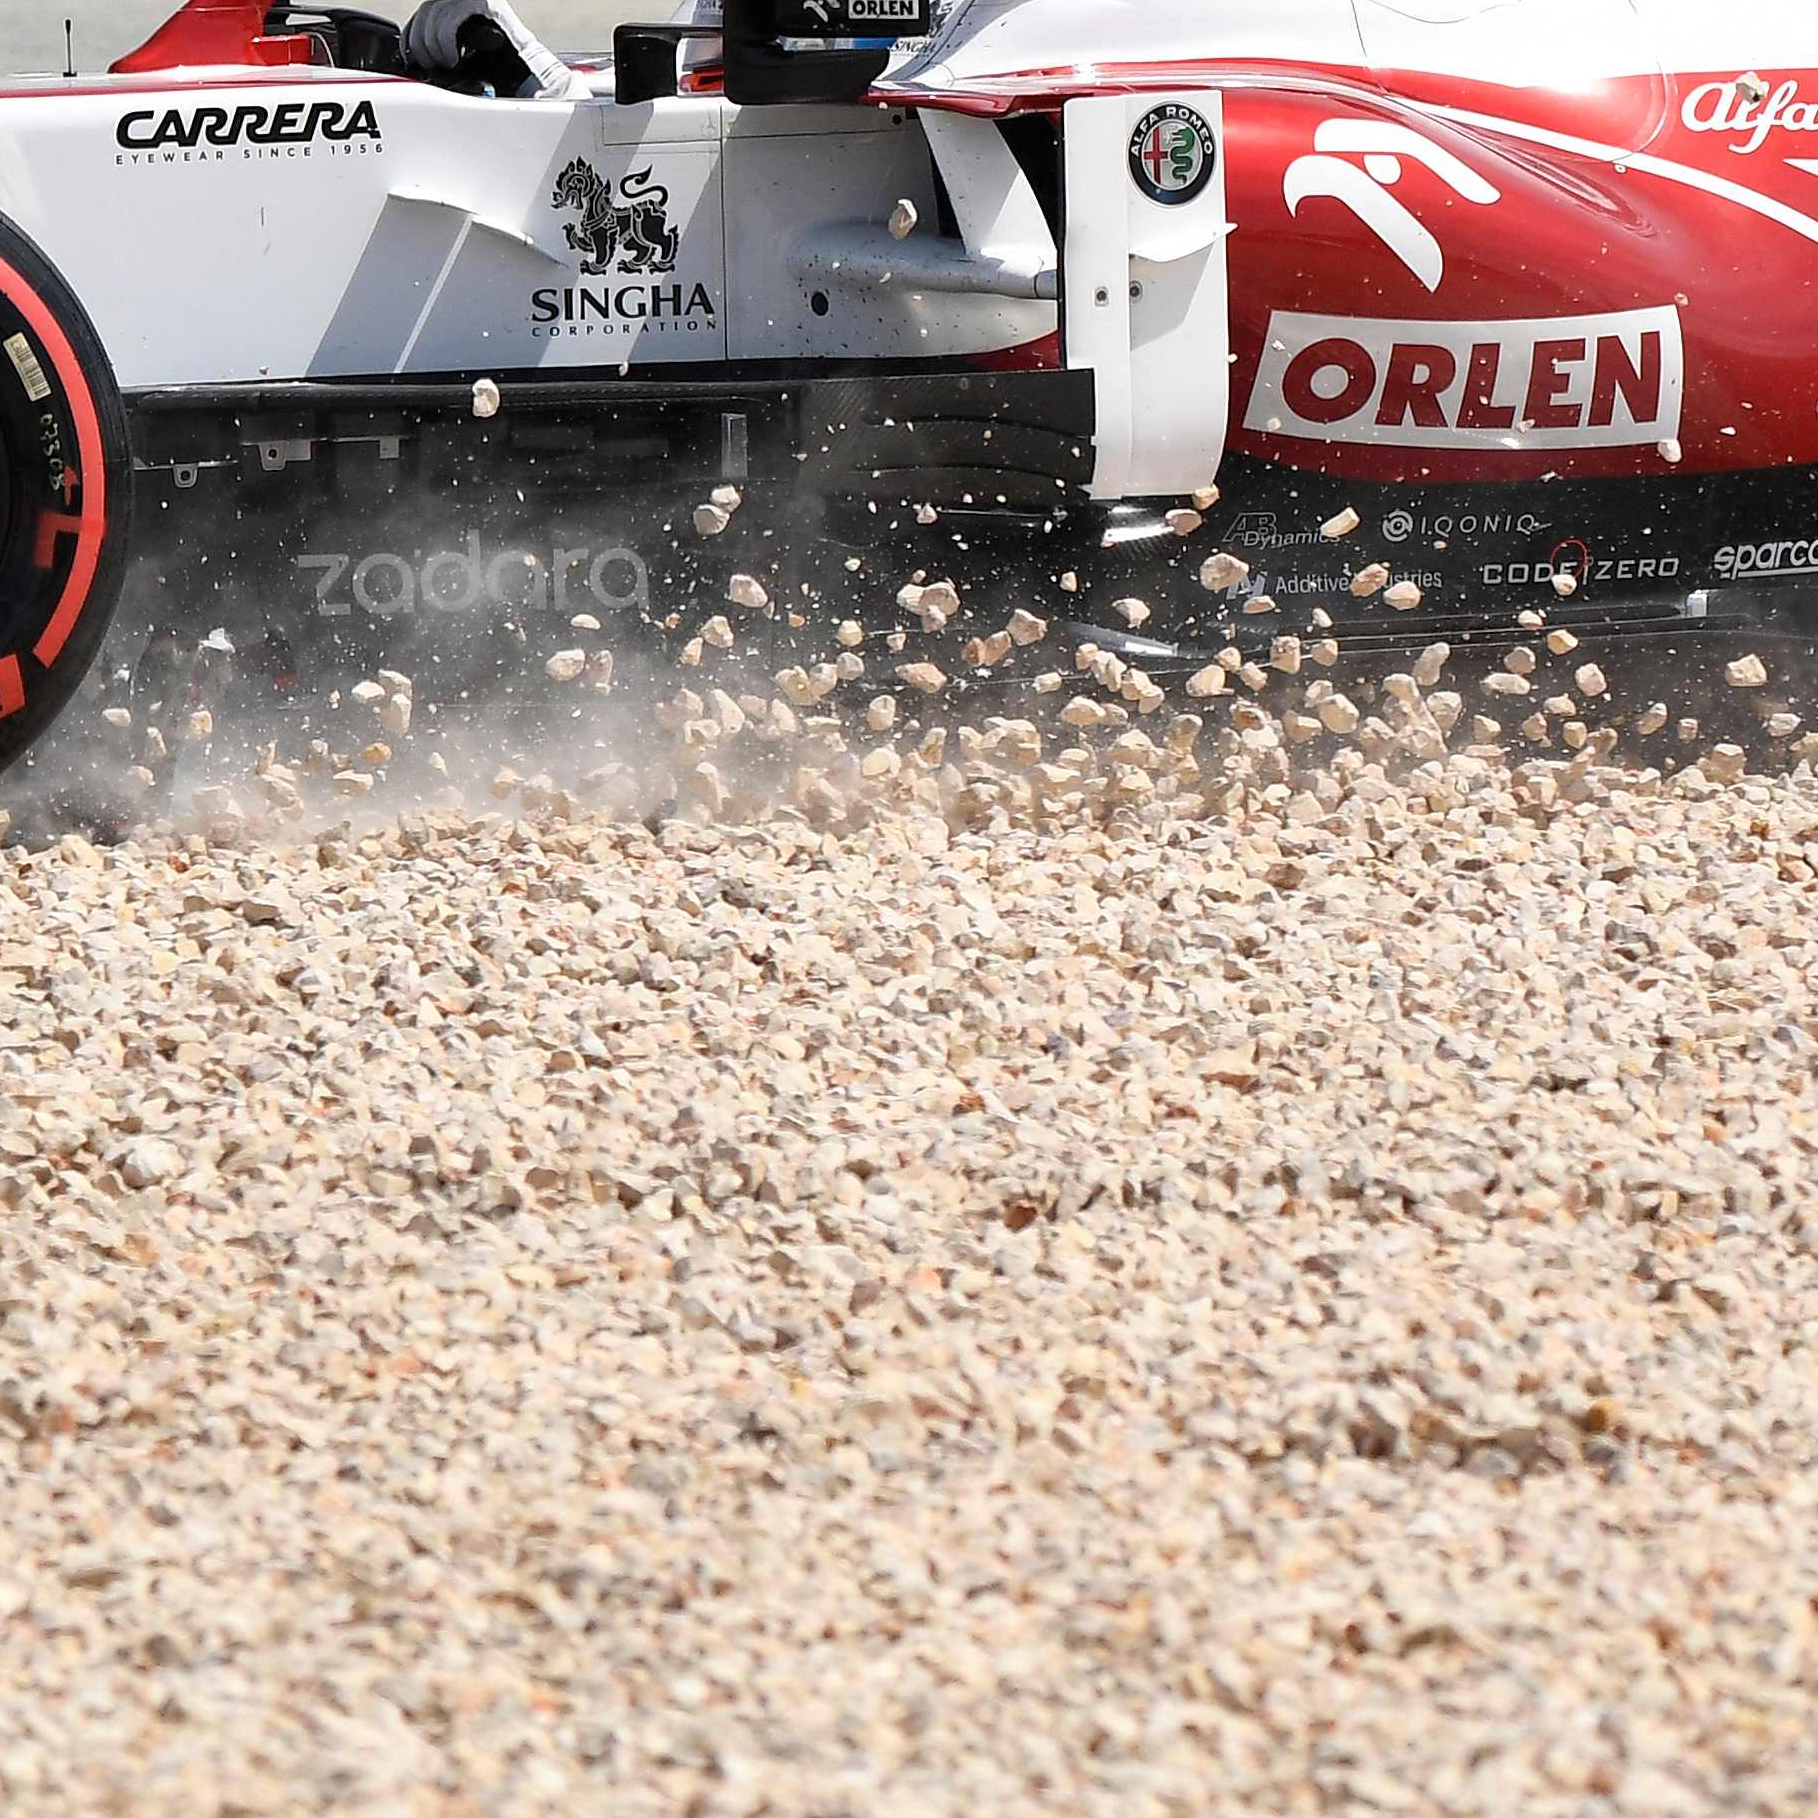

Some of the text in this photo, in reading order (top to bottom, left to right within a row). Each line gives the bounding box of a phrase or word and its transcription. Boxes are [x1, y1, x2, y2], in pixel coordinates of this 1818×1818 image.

[115, 100, 382, 150] CARRERA
[1130, 106, 1213, 158] ALFA ROMEO
[115, 143, 383, 166] EYEWEAR SINCE 1956
[531, 282, 716, 323] SINGHA
[531, 320, 717, 338] CORPORATION
[1280, 330, 1664, 430] ORLEN
[296, 529, 651, 617] zadara
[1274, 573, 1350, 595] Additive
